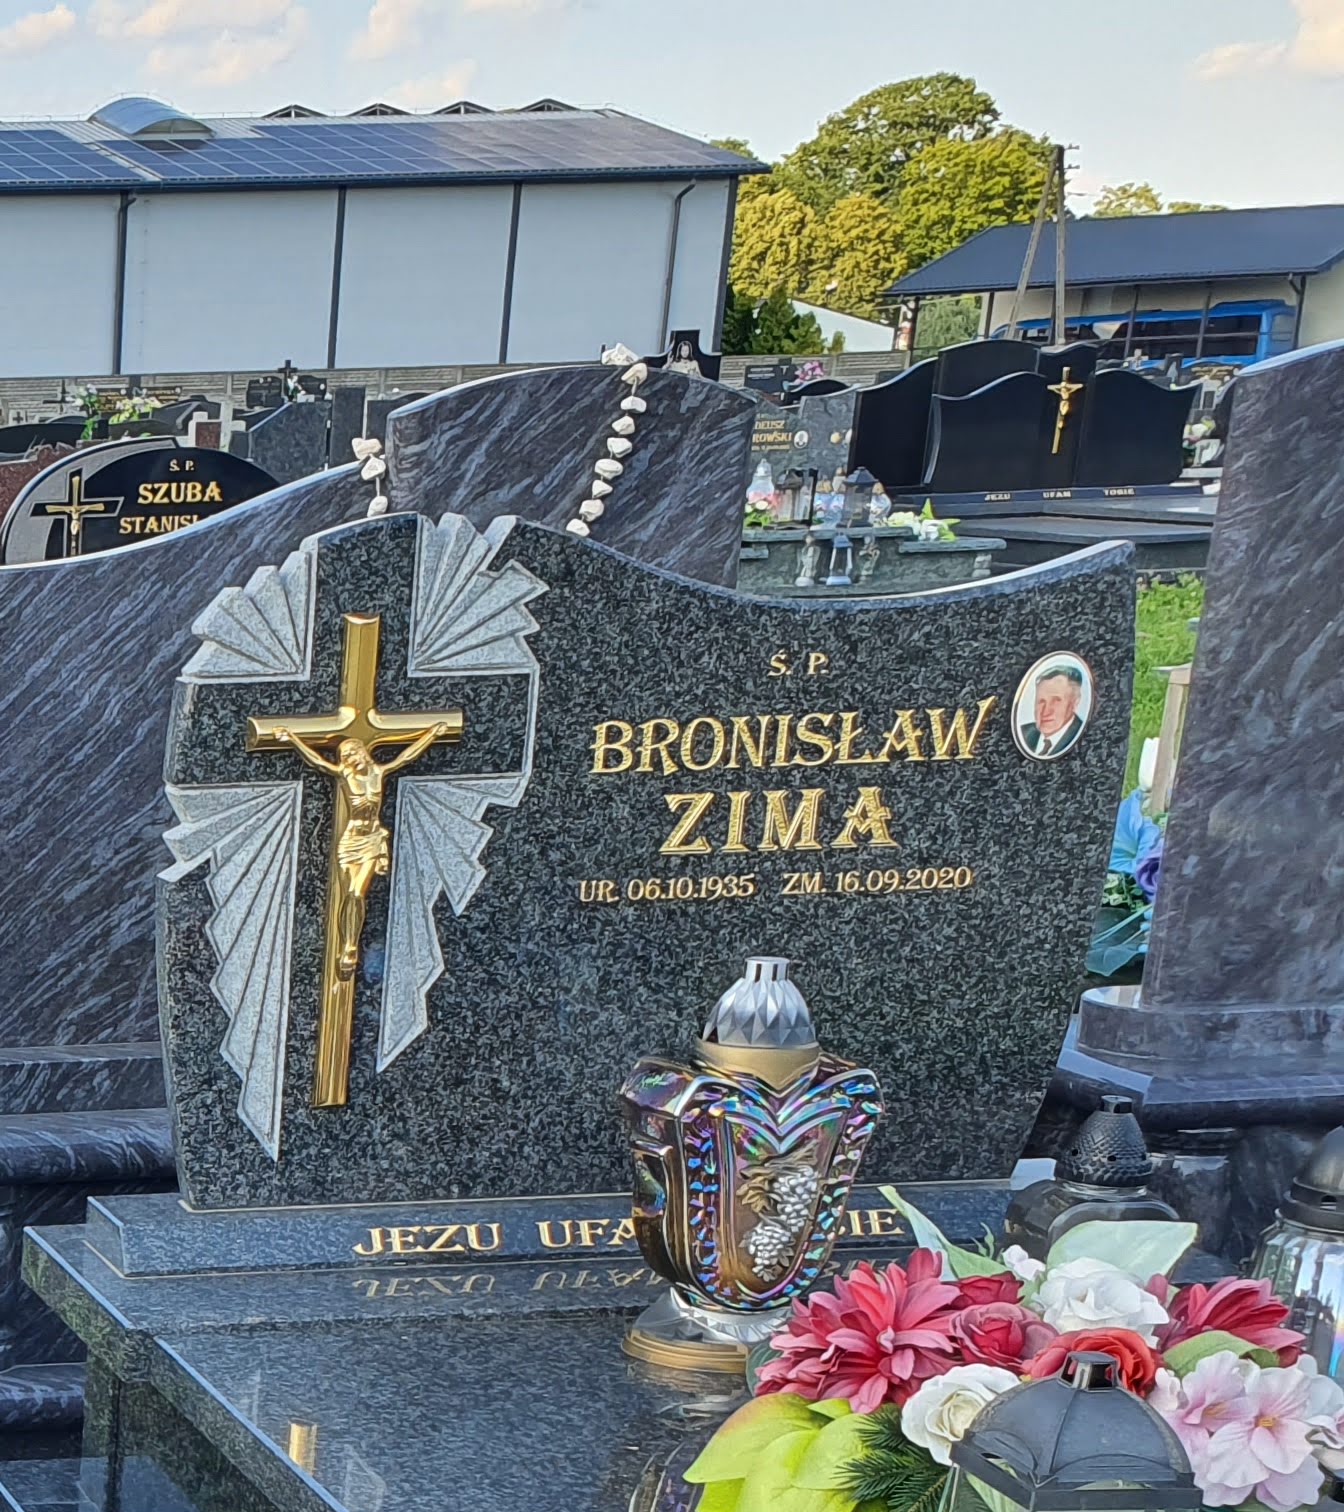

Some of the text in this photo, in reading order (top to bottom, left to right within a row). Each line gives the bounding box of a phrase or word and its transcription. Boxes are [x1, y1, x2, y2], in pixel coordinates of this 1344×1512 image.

[137, 481, 223, 504] SZUBA
[984, 493, 1011, 501] JEZU
[1103, 488, 1135, 496] TOBIE
[588, 696, 997, 776] BRONISŁAW
[659, 785, 900, 855] ZIMA
[626, 872, 756, 901] 06.10.1935
[781, 872, 825, 897] ZM.
[834, 866, 975, 893] 16.09.2020
[352, 1222, 502, 1256] JEZU
[534, 1218, 636, 1248] UFA
